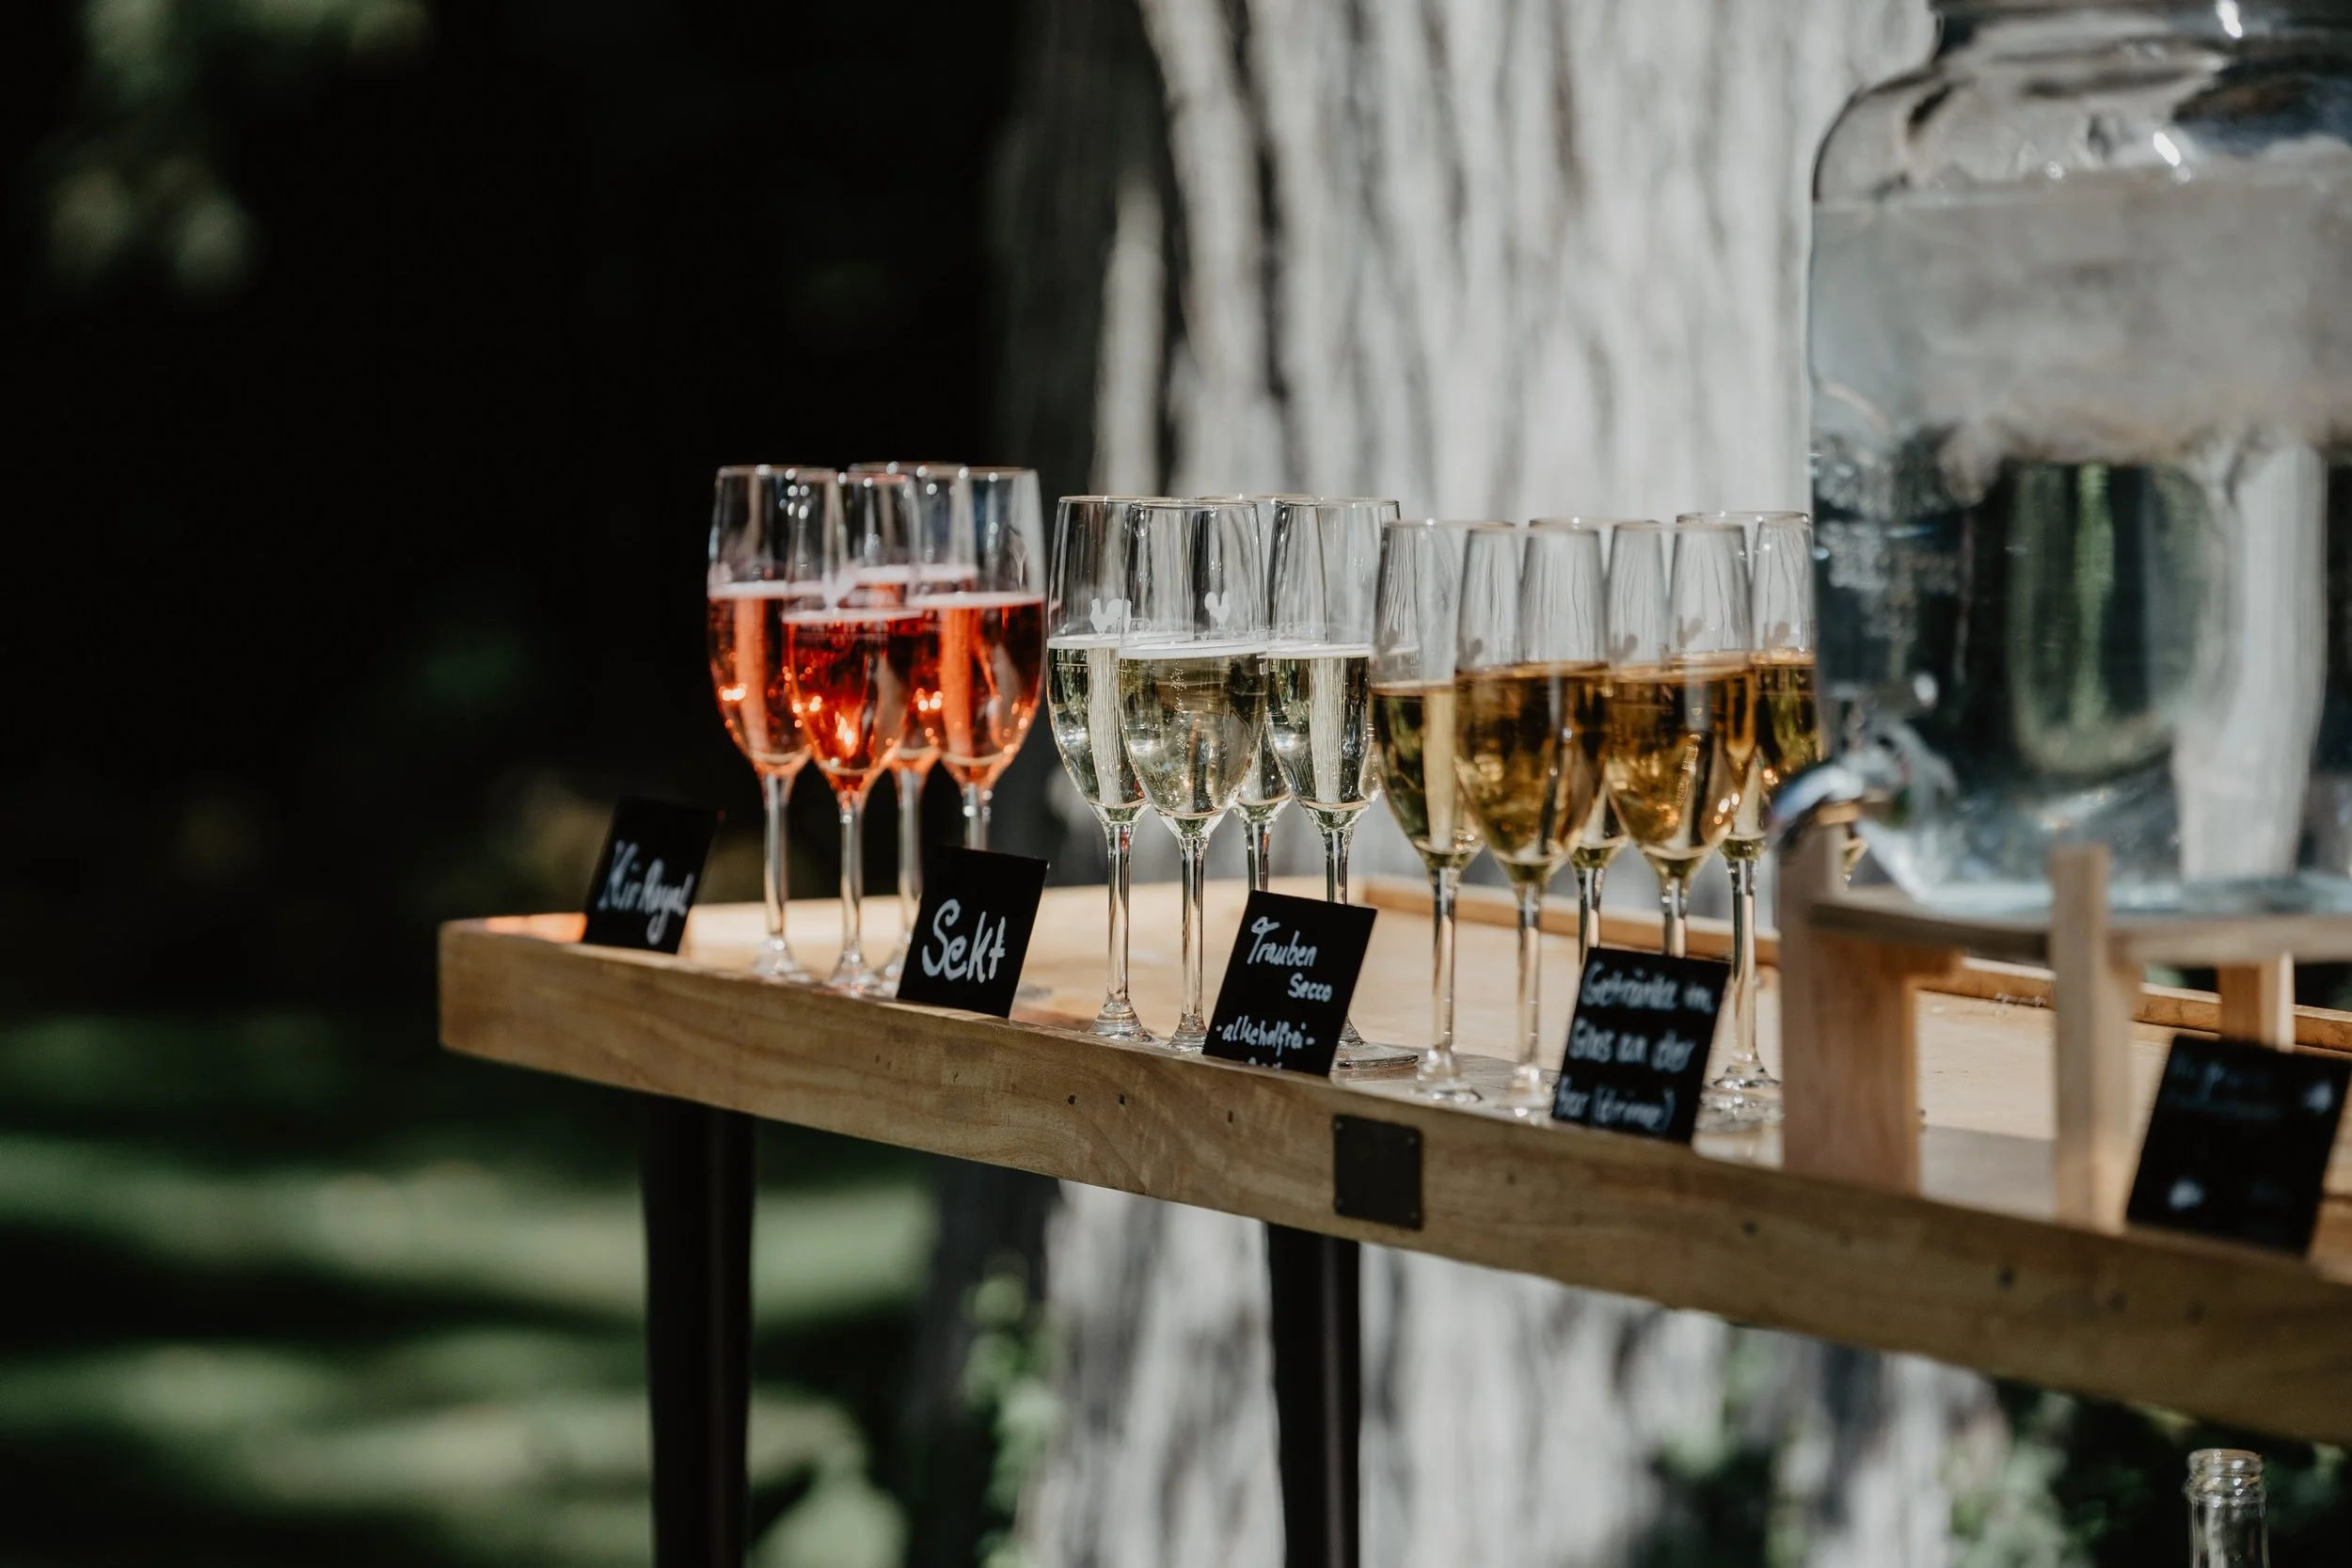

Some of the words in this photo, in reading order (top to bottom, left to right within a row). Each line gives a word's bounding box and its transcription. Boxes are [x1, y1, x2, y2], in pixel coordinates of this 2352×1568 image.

[597, 840, 642, 911] Kir
[922, 898, 1006, 983] Sekt
[1247, 916, 1317, 967] Trauben
[1287, 973, 1332, 1002] Secco
